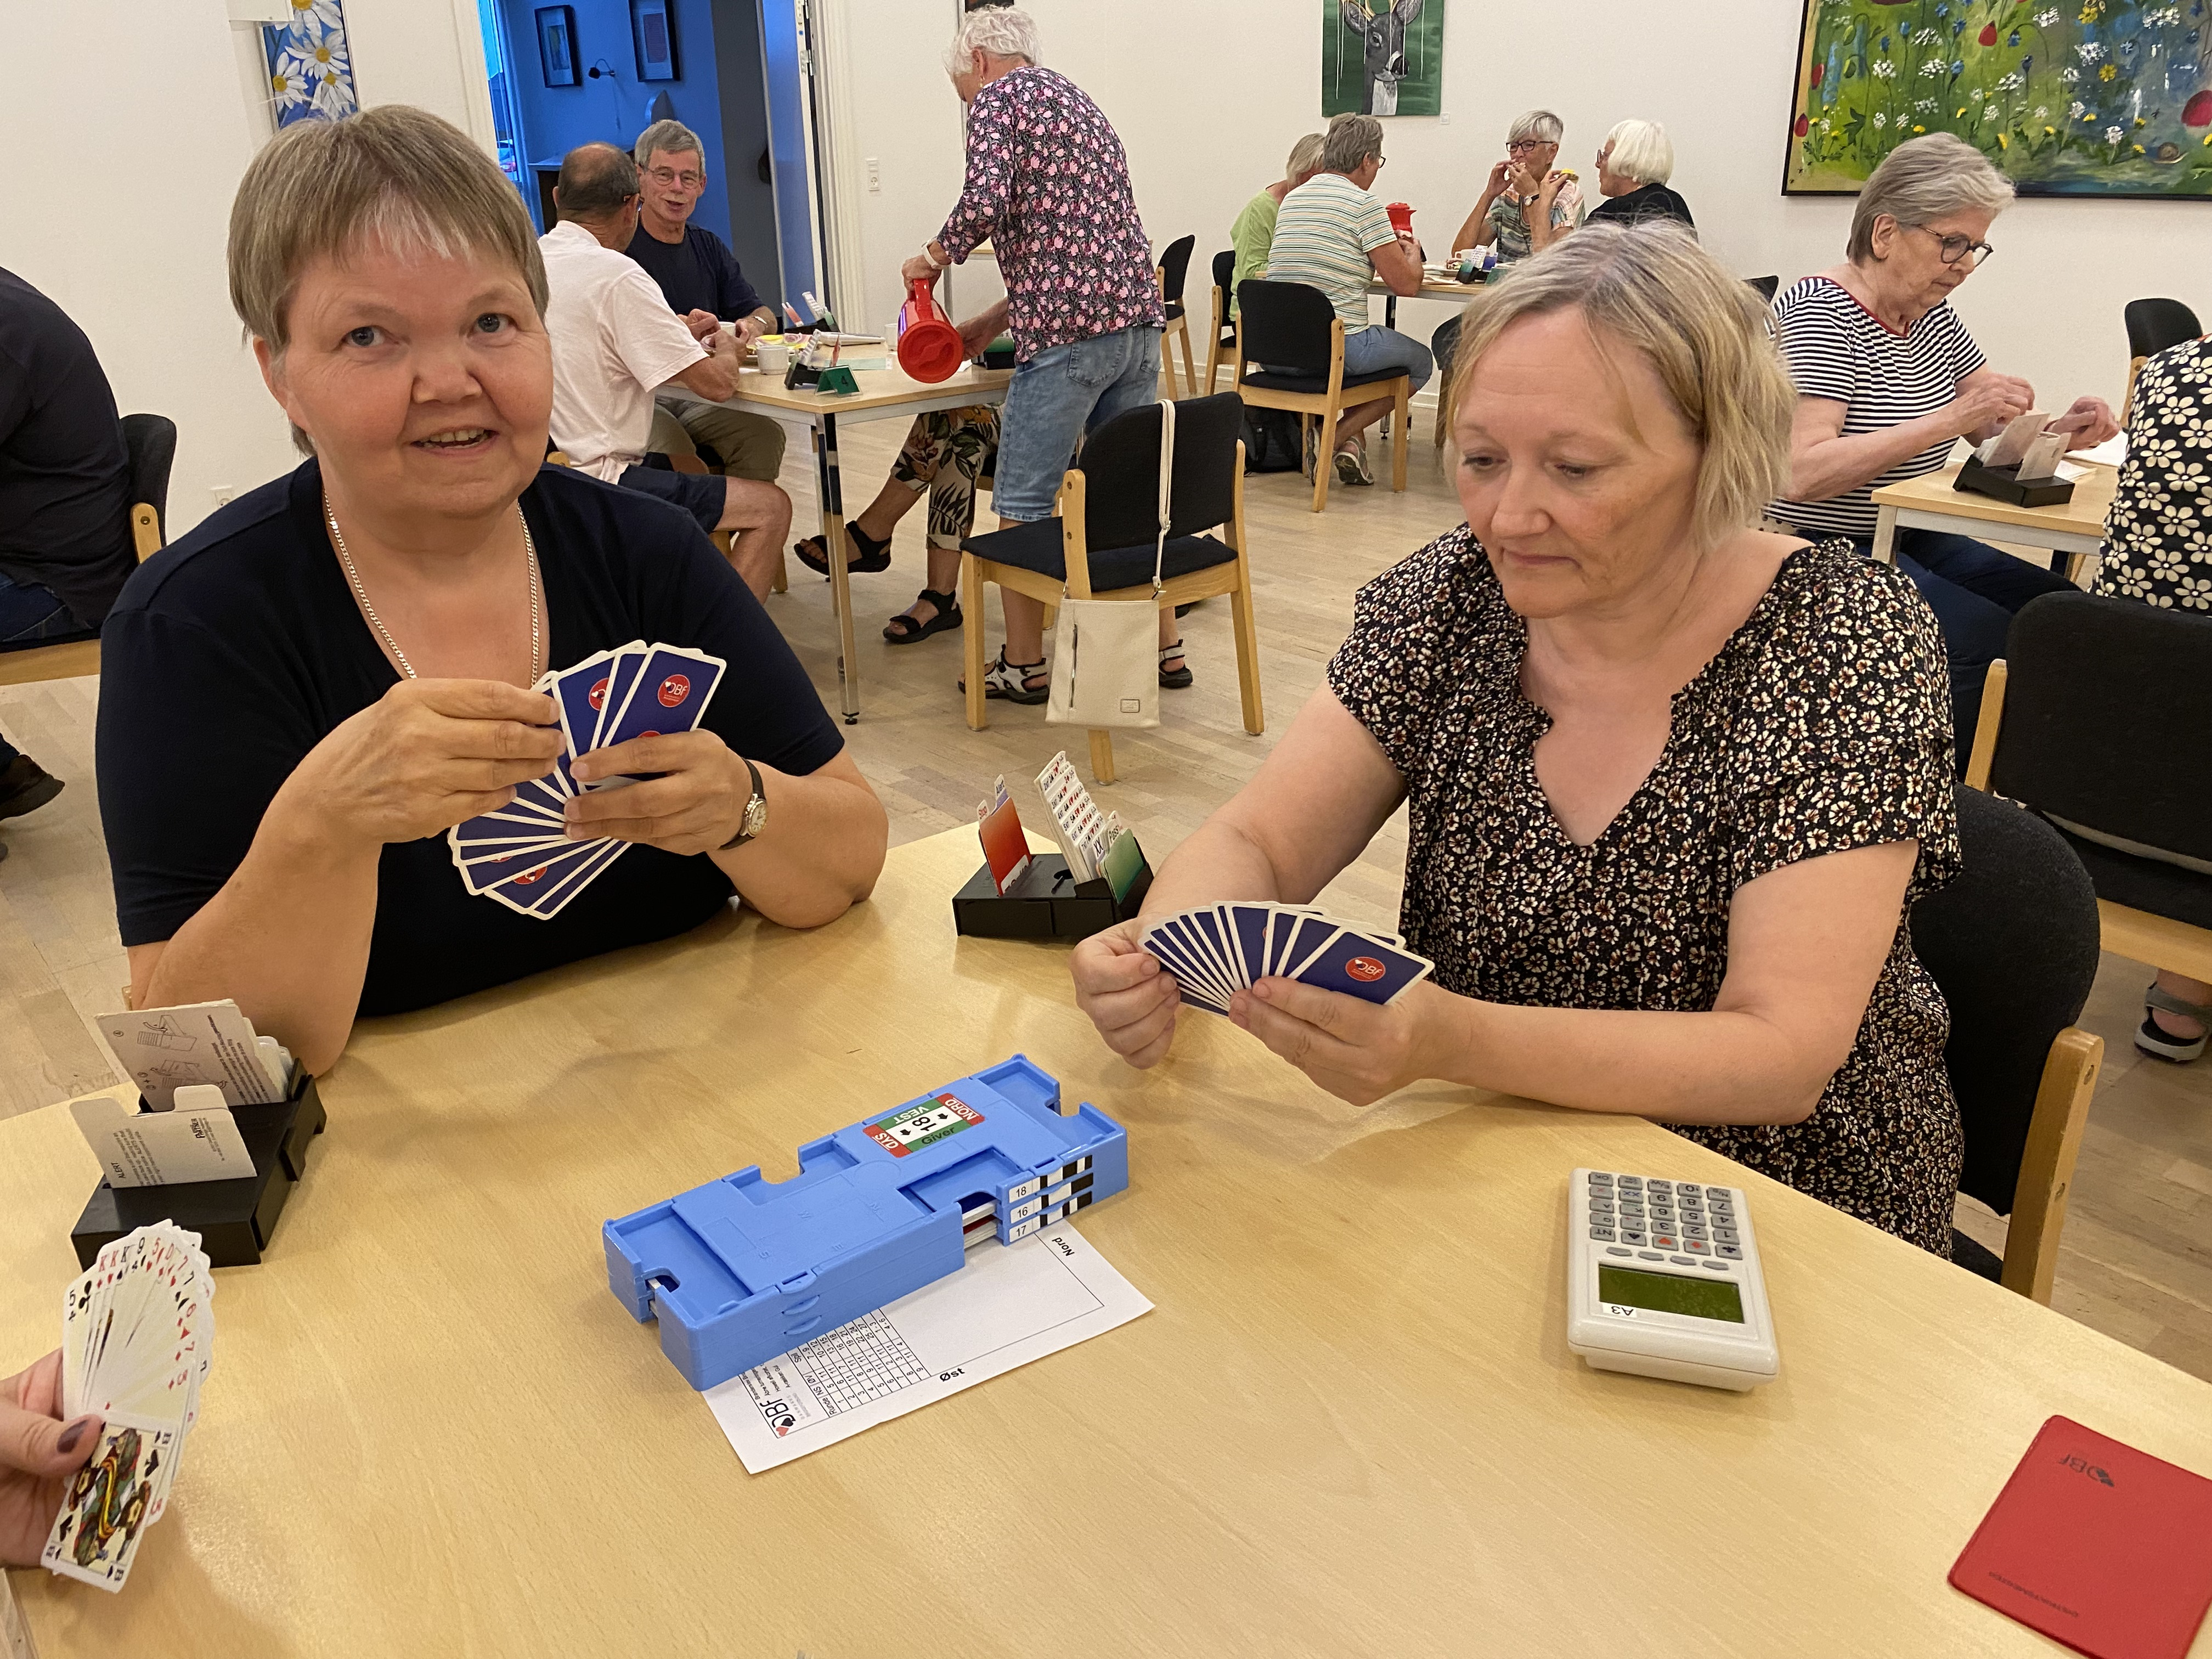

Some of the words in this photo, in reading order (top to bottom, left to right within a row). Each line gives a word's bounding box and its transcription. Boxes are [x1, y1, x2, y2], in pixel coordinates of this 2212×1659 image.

[893, 1106, 929, 1125] VEST
[945, 1098, 977, 1120] NORD
[912, 1116, 936, 1132] 18
[874, 1133, 899, 1149] SYD
[922, 1127, 955, 1145] Giver
[111, 1163, 126, 1178] ALERT
[1015, 1186, 1026, 1197] 18
[1017, 1207, 1028, 1218] 16
[1016, 1225, 1026, 1237] 17
[121, 1244, 132, 1262] K
[137, 1237, 145, 1254] 9
[152, 1237, 161, 1255] 5
[1052, 1237, 1075, 1256] Nord
[99, 1254, 108, 1272] K
[110, 1250, 119, 1267] K
[177, 1255, 188, 1271] 7
[69, 1289, 76, 1306] 5
[1611, 1306, 1634, 1316] A3
[185, 1341, 195, 1351] 7
[791, 1352, 802, 1363] Spil
[805, 1375, 816, 1383] ØV
[940, 1368, 965, 1382] Øst
[813, 1386, 824, 1396] NS
[822, 1397, 837, 1415] Runde
